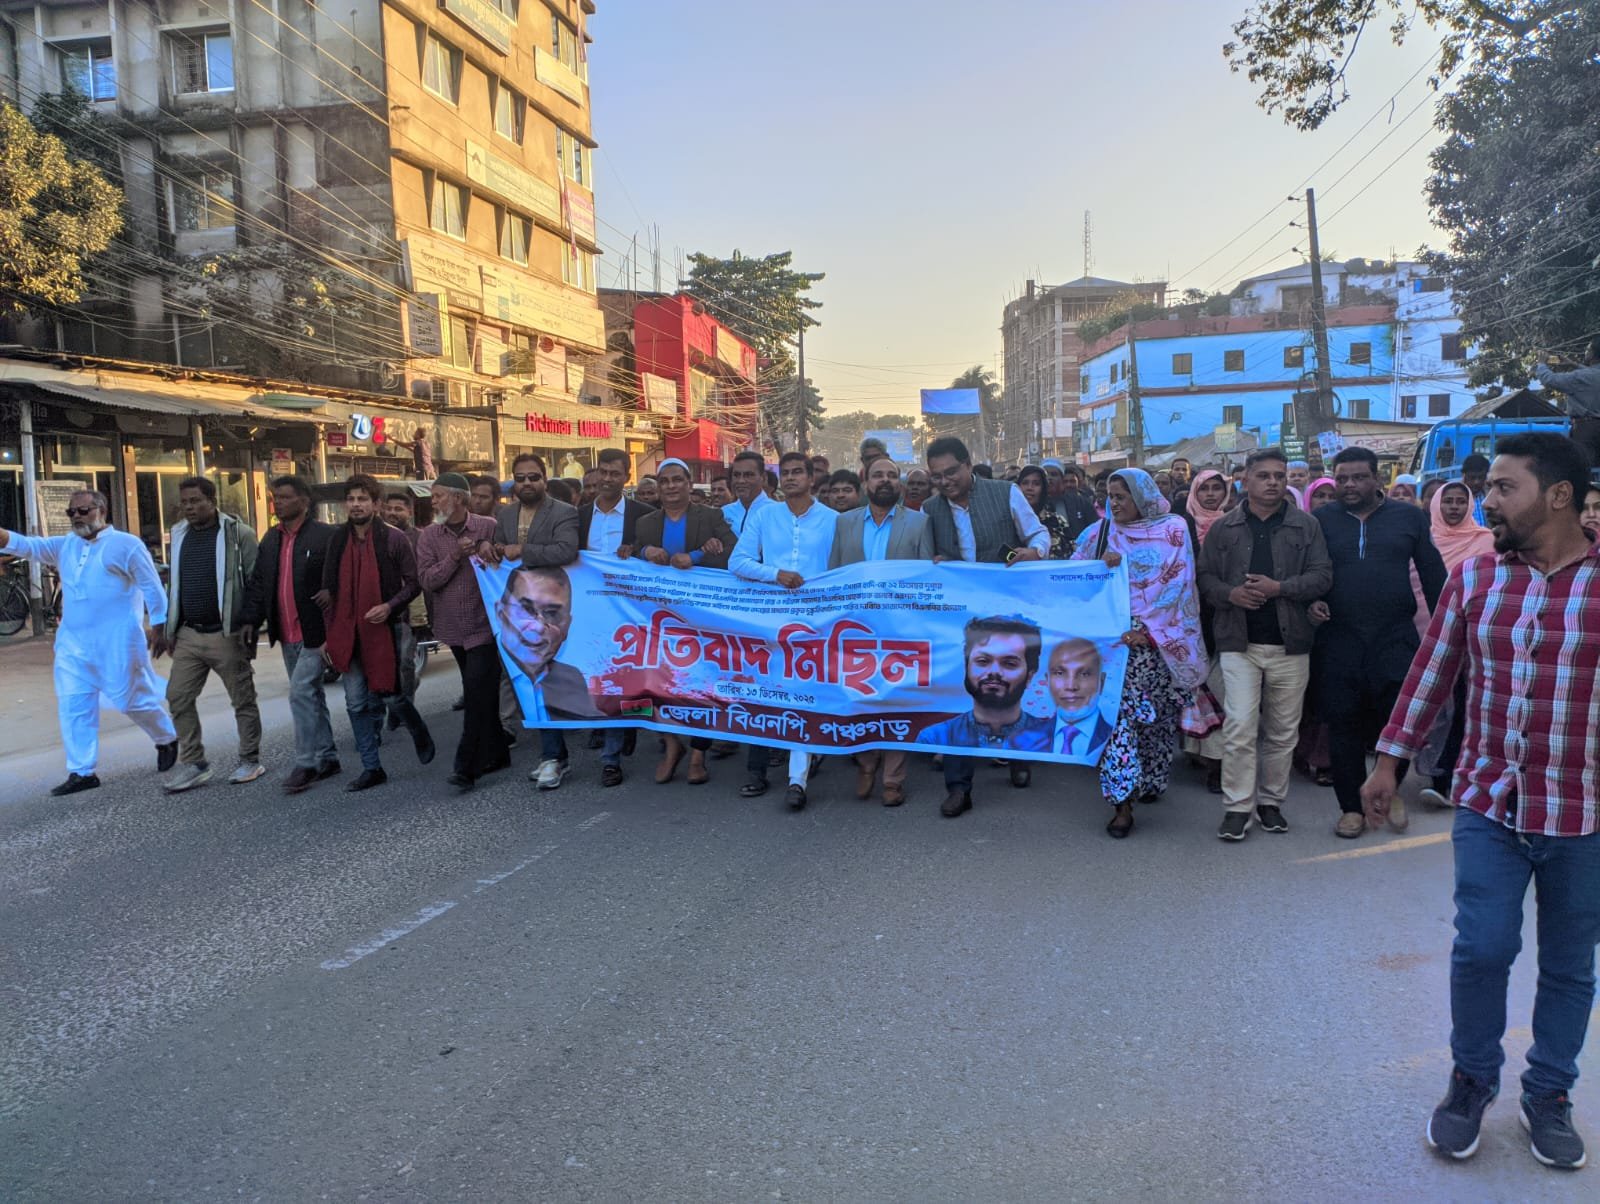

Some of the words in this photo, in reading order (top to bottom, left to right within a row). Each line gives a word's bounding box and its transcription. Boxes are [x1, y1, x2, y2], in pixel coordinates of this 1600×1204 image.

[524, 412, 571, 435] Richman
[577, 419, 612, 439] LUBNAN
[612, 610, 771, 675] প্রতিবাদ
[777, 619, 931, 696] মিছিল
[746, 687, 758, 697] ১৩
[793, 694, 816, 705] ২০২৫
[659, 704, 720, 728] জেলা
[726, 703, 811, 742] বিএনপি,
[819, 718, 912, 743] পঞ্চগড়
